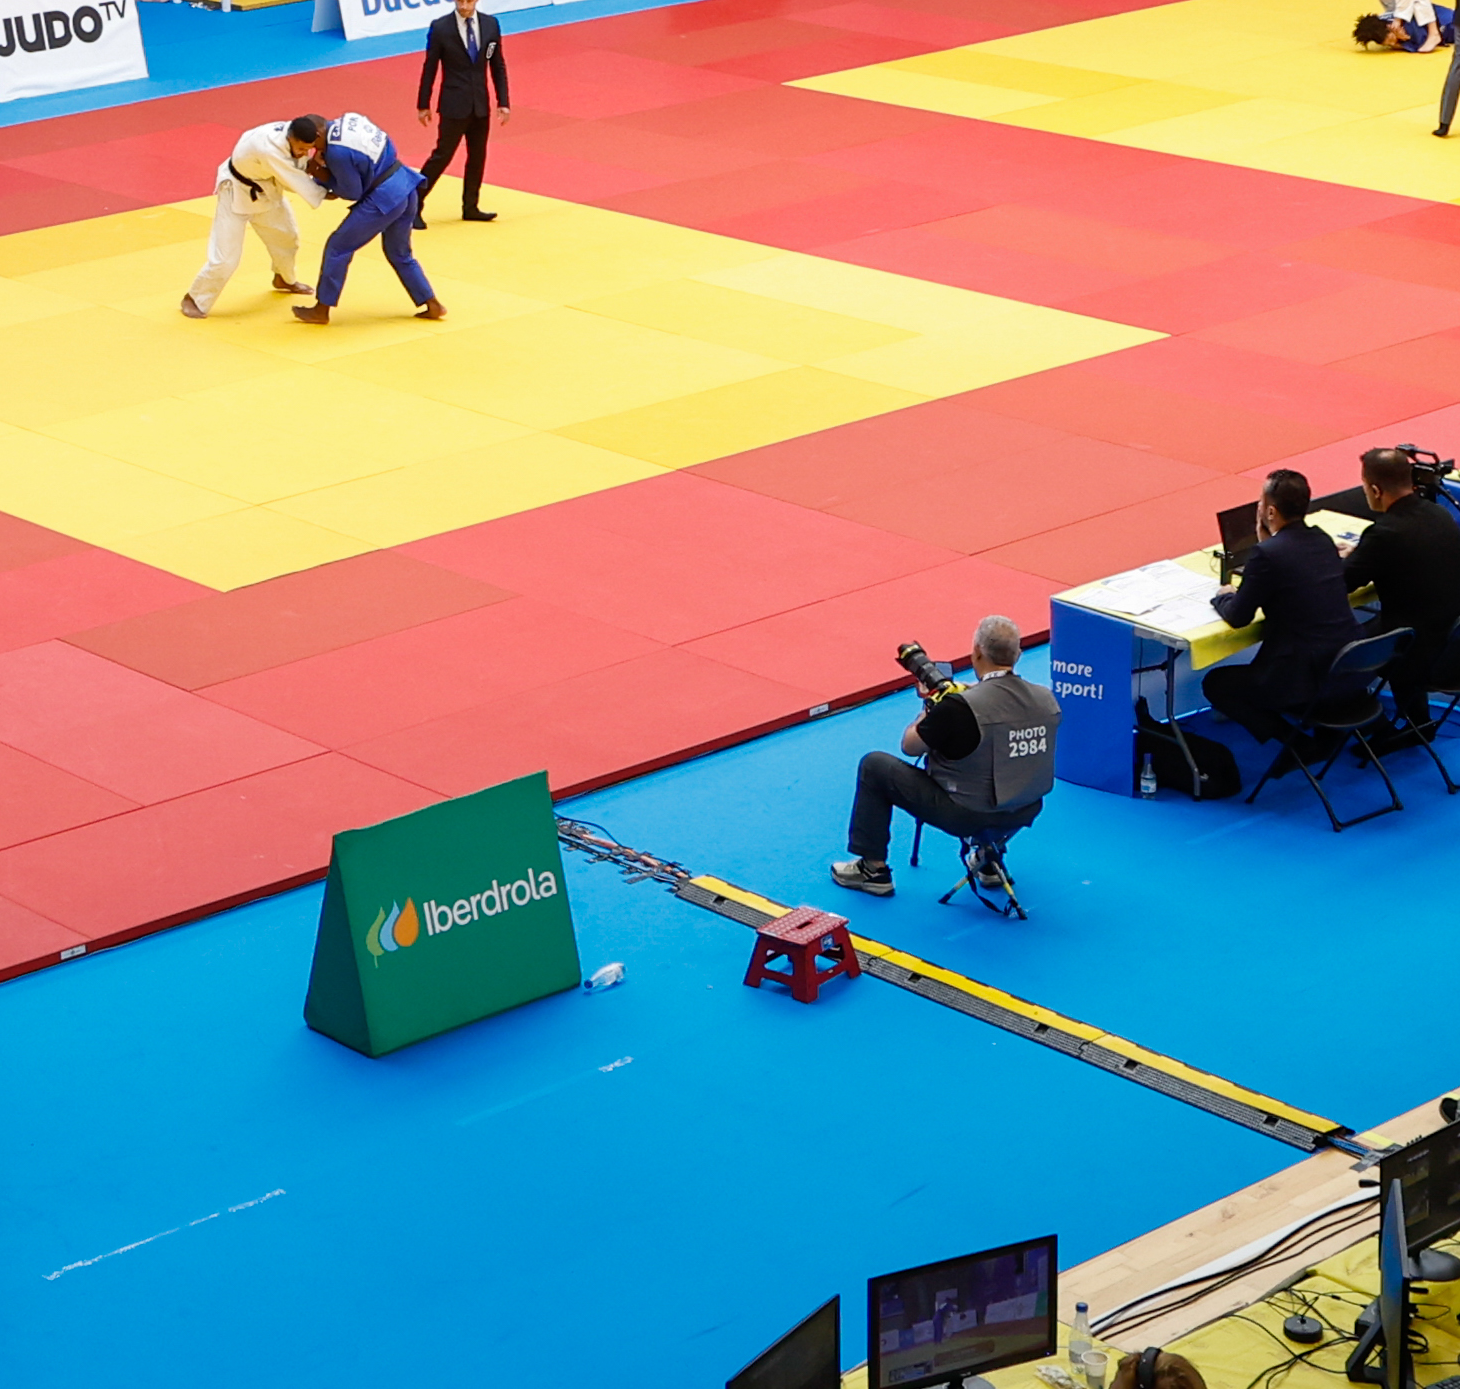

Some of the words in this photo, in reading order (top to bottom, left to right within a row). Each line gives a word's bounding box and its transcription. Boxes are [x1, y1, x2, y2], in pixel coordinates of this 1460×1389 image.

[1056, 678, 1104, 702] sport!
[1008, 725, 1047, 744] PHOTO
[1008, 738, 1048, 758] 2984
[423, 867, 557, 937] Iberdrola
